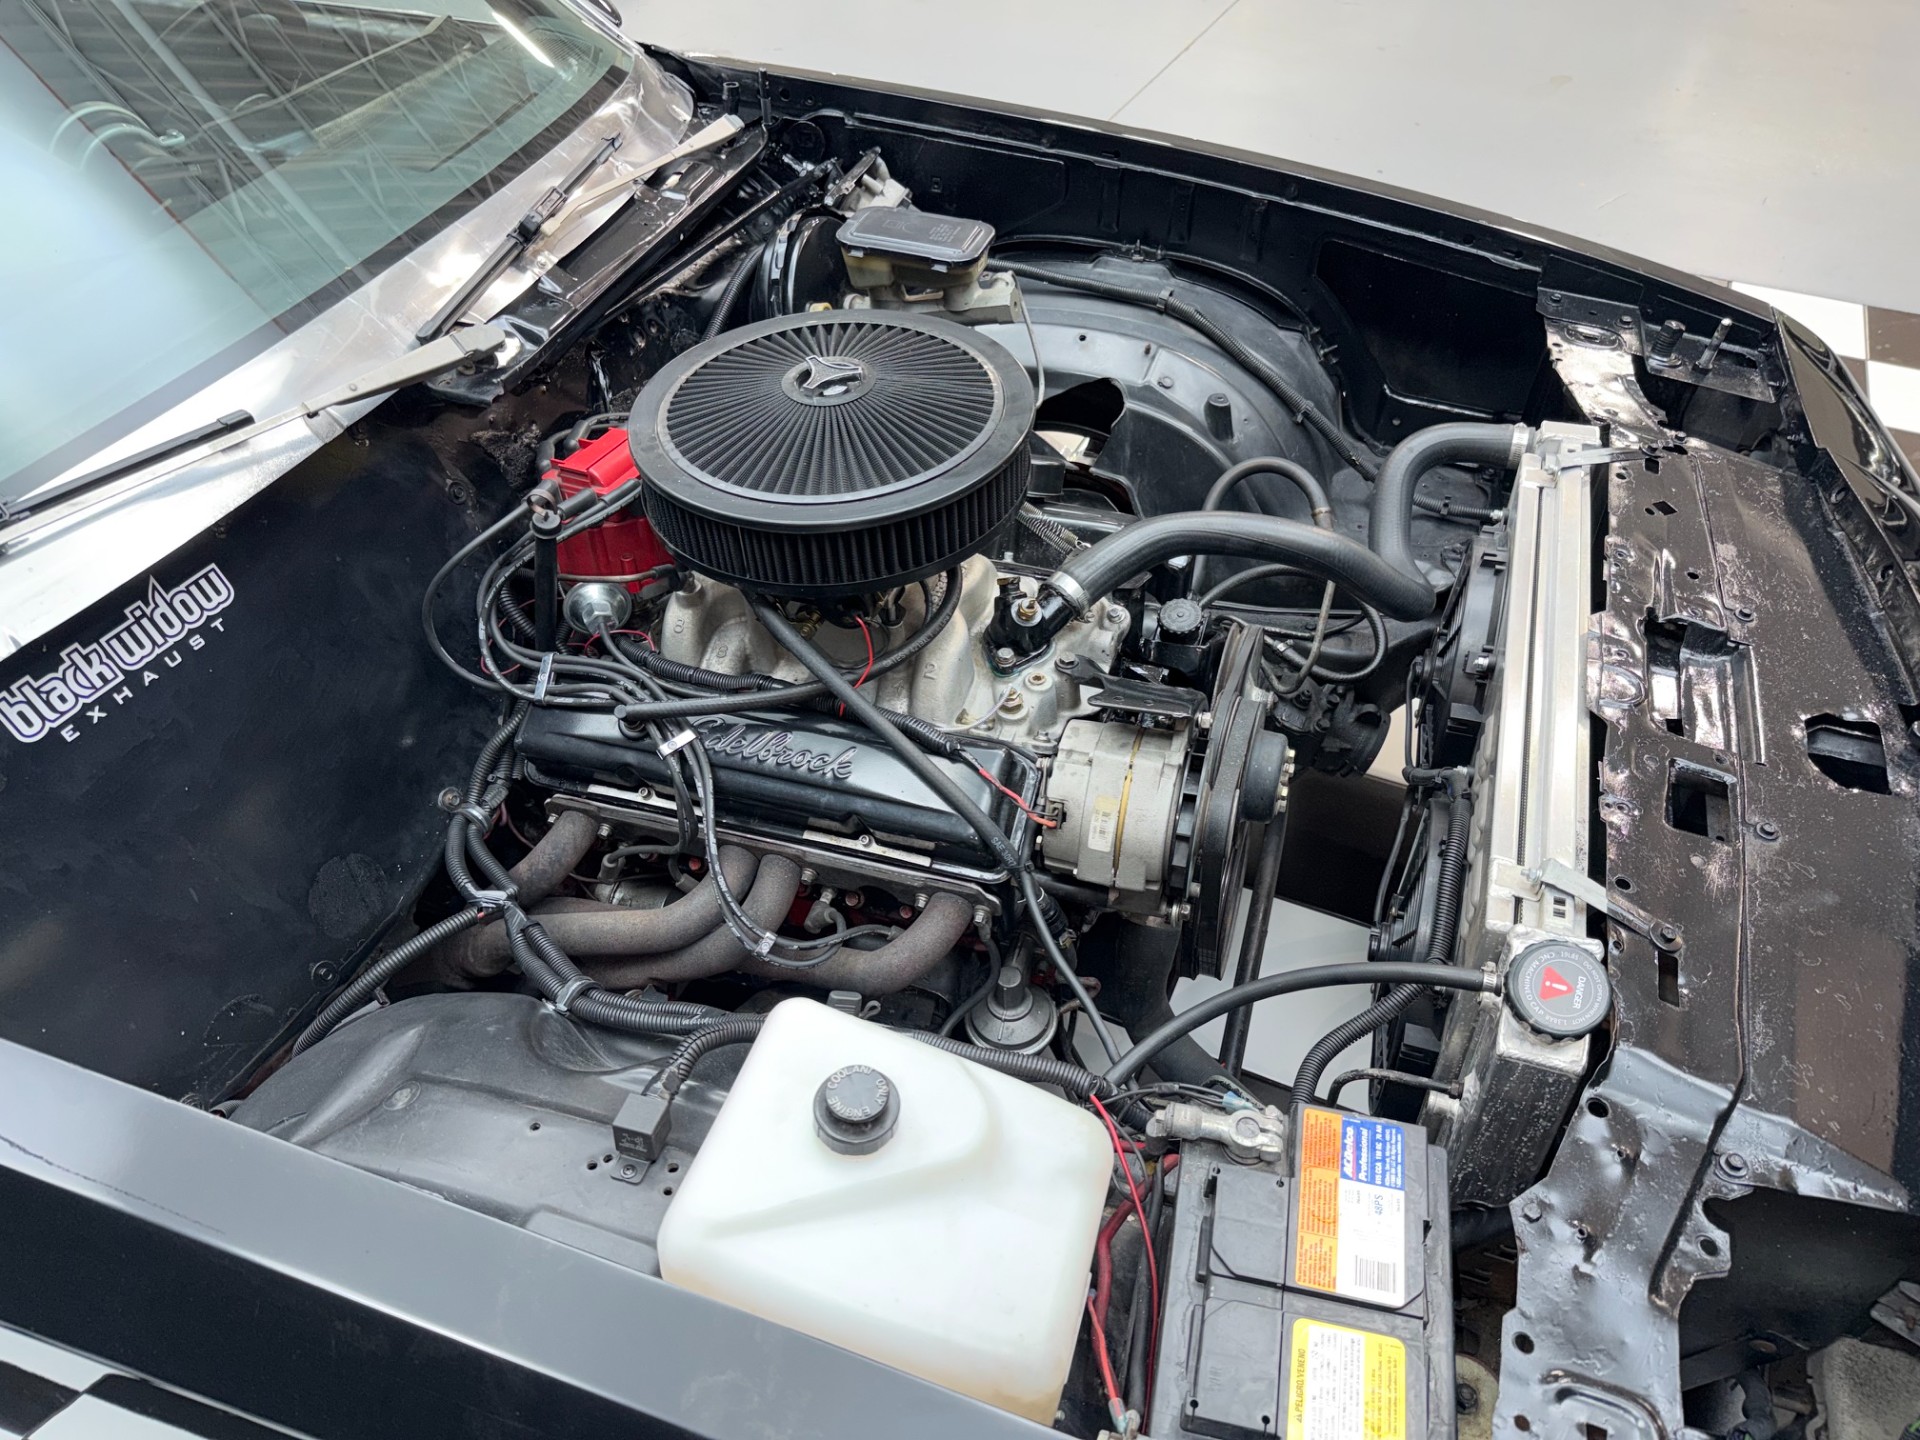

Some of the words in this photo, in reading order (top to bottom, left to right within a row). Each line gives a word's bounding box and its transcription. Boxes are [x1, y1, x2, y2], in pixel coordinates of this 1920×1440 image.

[60, 617, 225, 742] EXHAUST
[990, 836, 1005, 852] SAE
[1539, 951, 1555, 962] CNC
[1583, 961, 1592, 970] DO
[1523, 960, 1539, 1000] MACHINED
[1590, 969, 1601, 984] NOT
[1573, 976, 1586, 1009] DANGER
[1530, 1002, 1544, 1015] CAP
[1584, 1003, 1599, 1019] WHEN
[1572, 1017, 1585, 1025] HOT
[828, 1096, 871, 1118] ENGINE
[876, 1078, 889, 1105] ONLY
[1343, 1126, 1354, 1178] ACDelco
[1358, 1127, 1368, 1182] Professional
